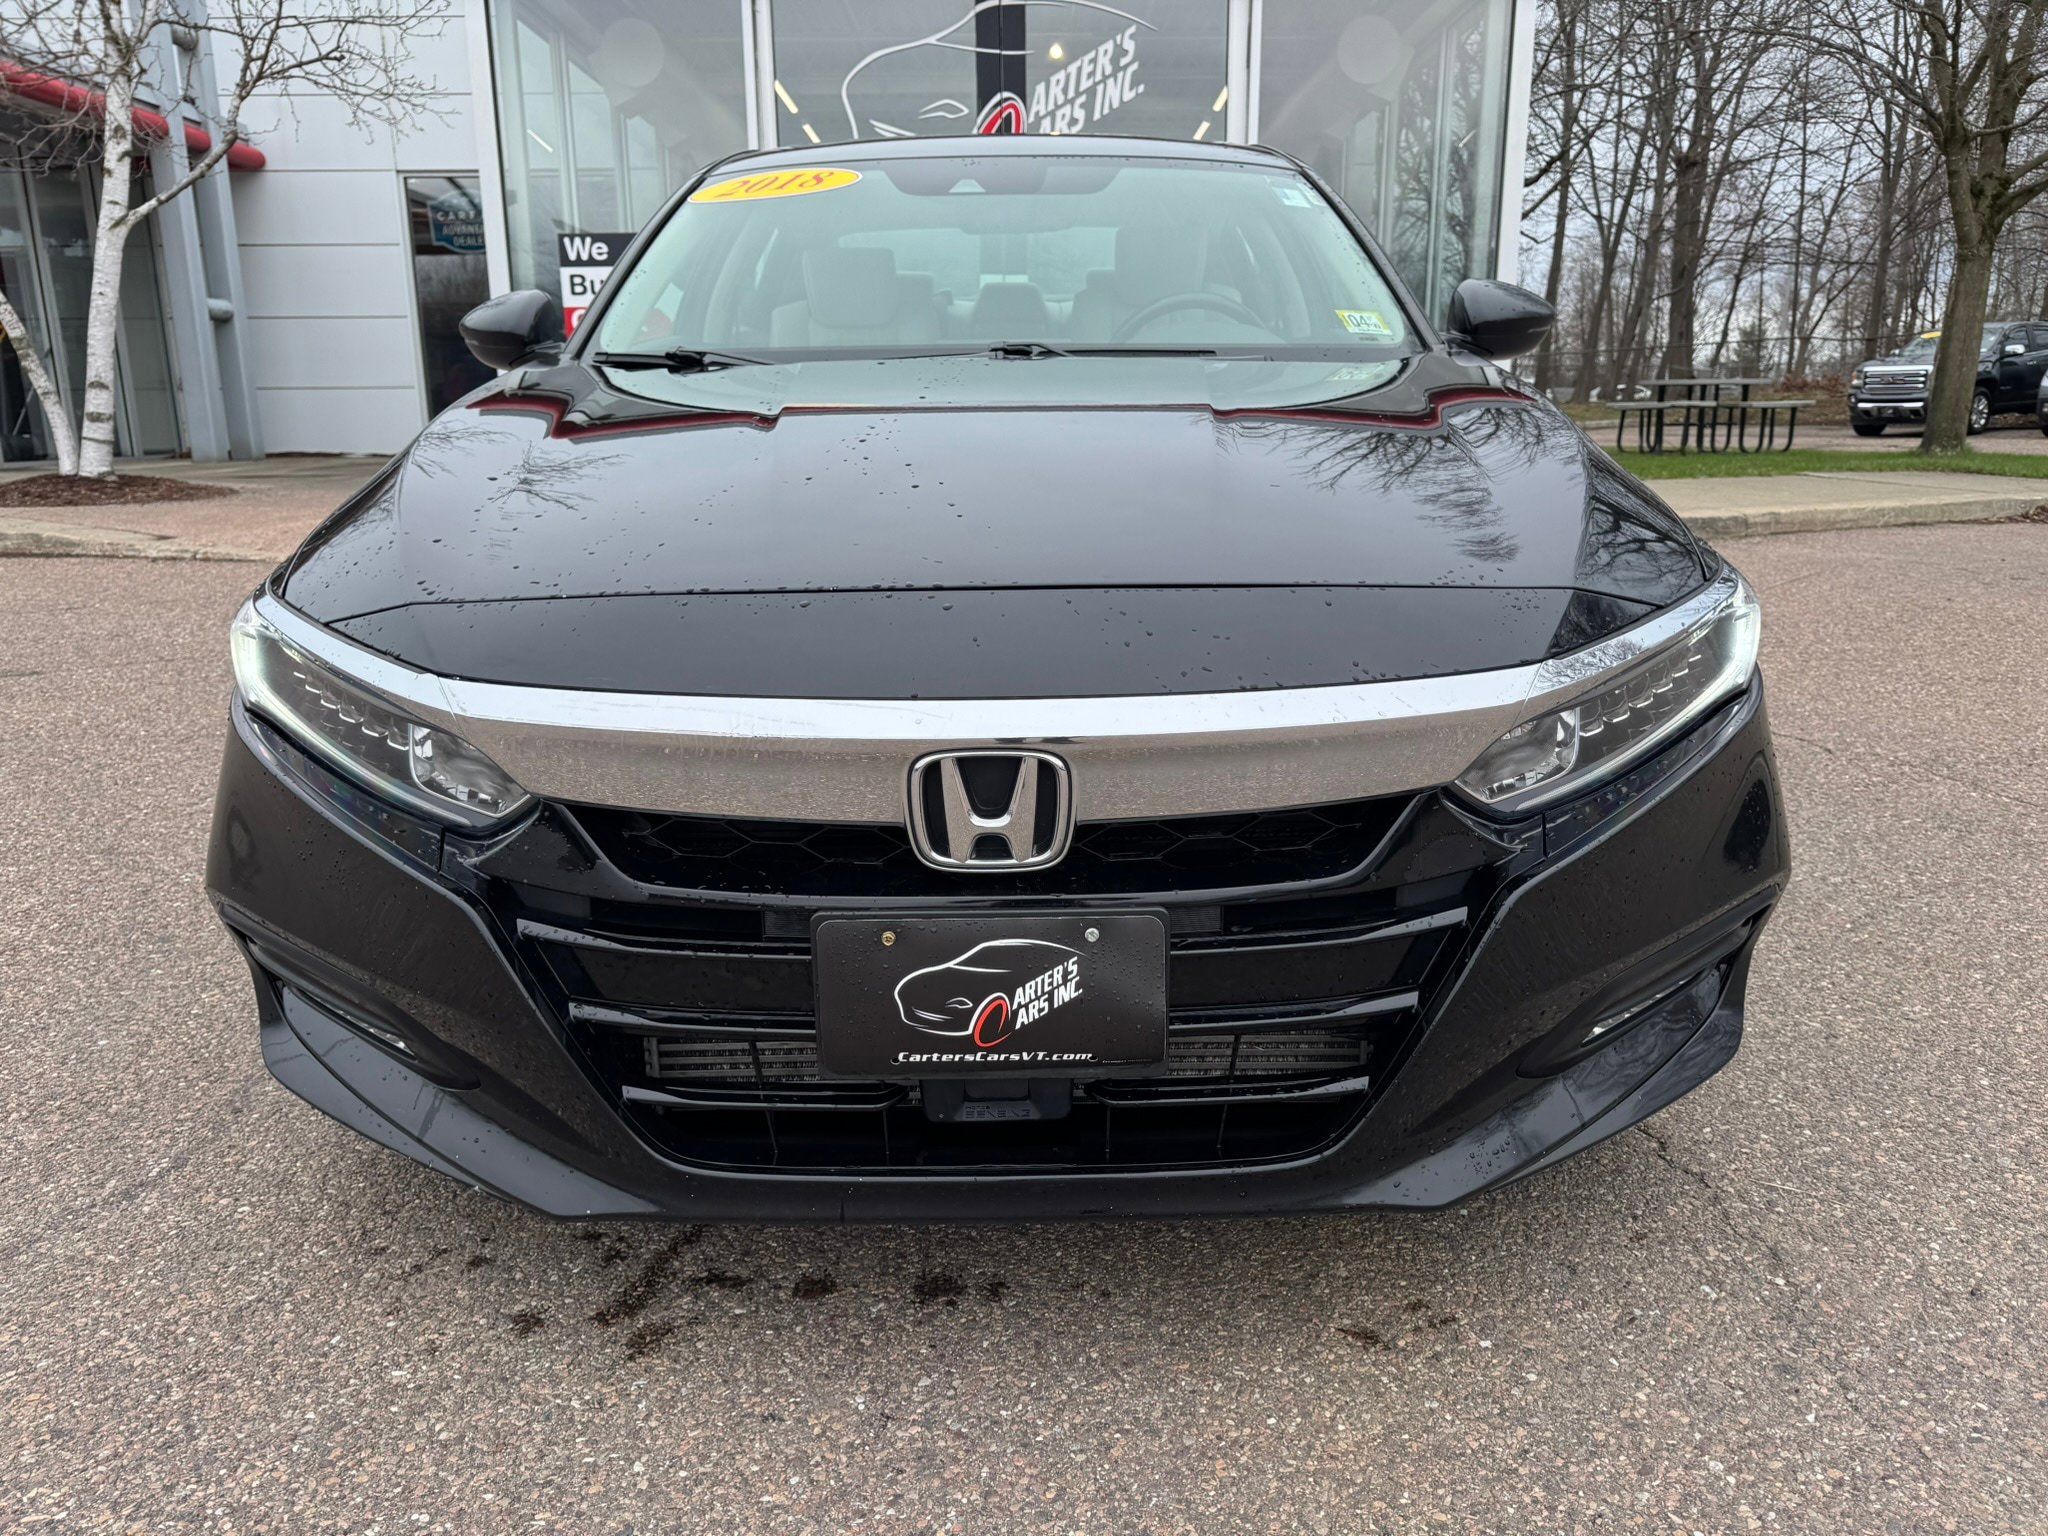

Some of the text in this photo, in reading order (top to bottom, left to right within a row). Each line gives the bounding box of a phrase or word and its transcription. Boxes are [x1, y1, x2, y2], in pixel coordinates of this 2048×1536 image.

[1093, 61, 1145, 122] INC.
[713, 171, 835, 198] 2018
[563, 236, 609, 261] We
[570, 274, 604, 296] Bu
[1053, 976, 1083, 1009] INC.
[898, 1052, 1093, 1063] CartersCarsVT.com
